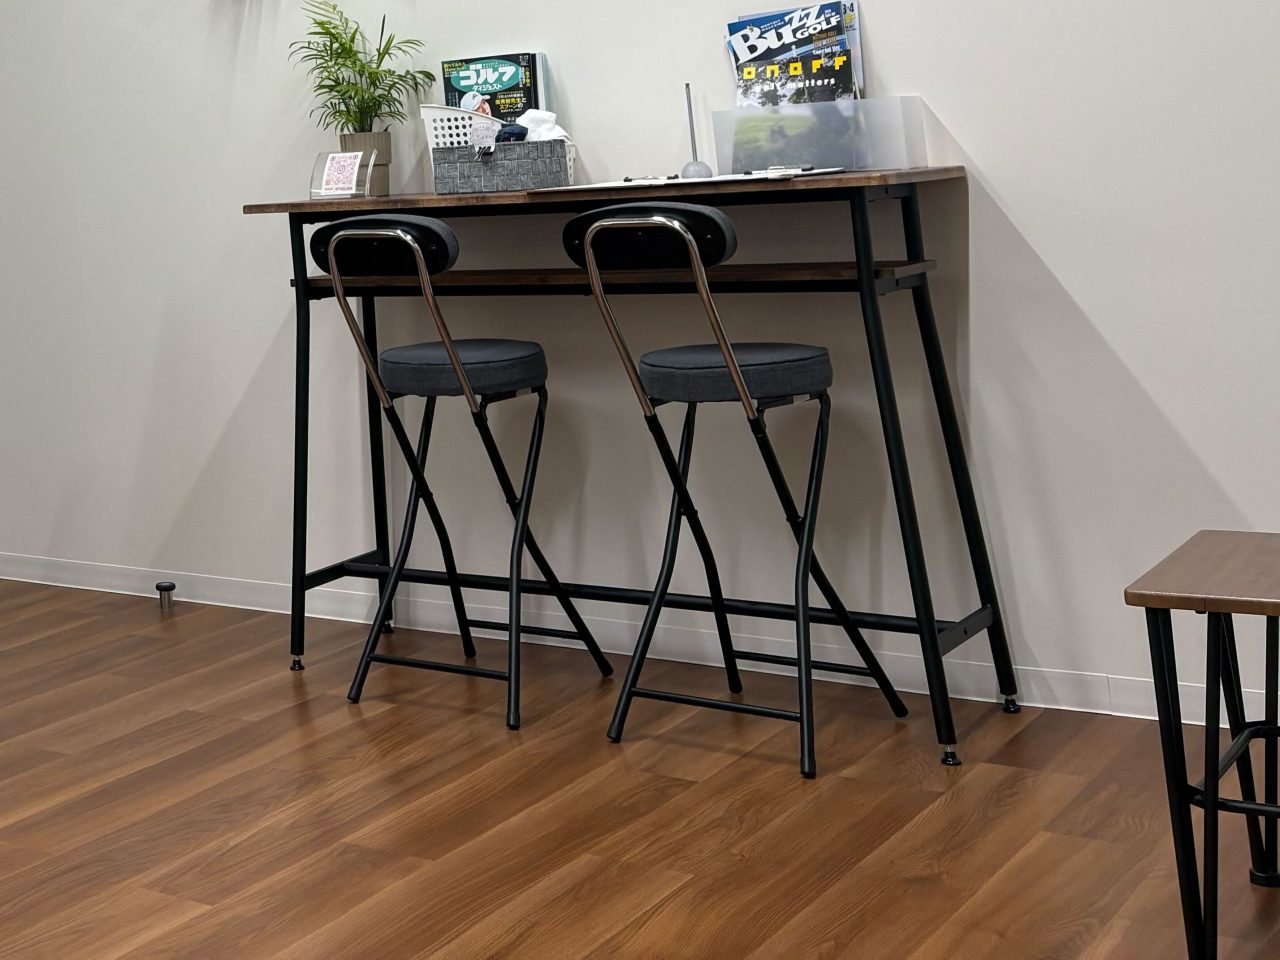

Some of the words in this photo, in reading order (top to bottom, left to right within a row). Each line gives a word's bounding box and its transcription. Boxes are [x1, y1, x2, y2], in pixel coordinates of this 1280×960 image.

[795, 15, 841, 39] GOLF
[459, 66, 516, 86] ゴルフ
[472, 83, 503, 92] ダイジェスト
